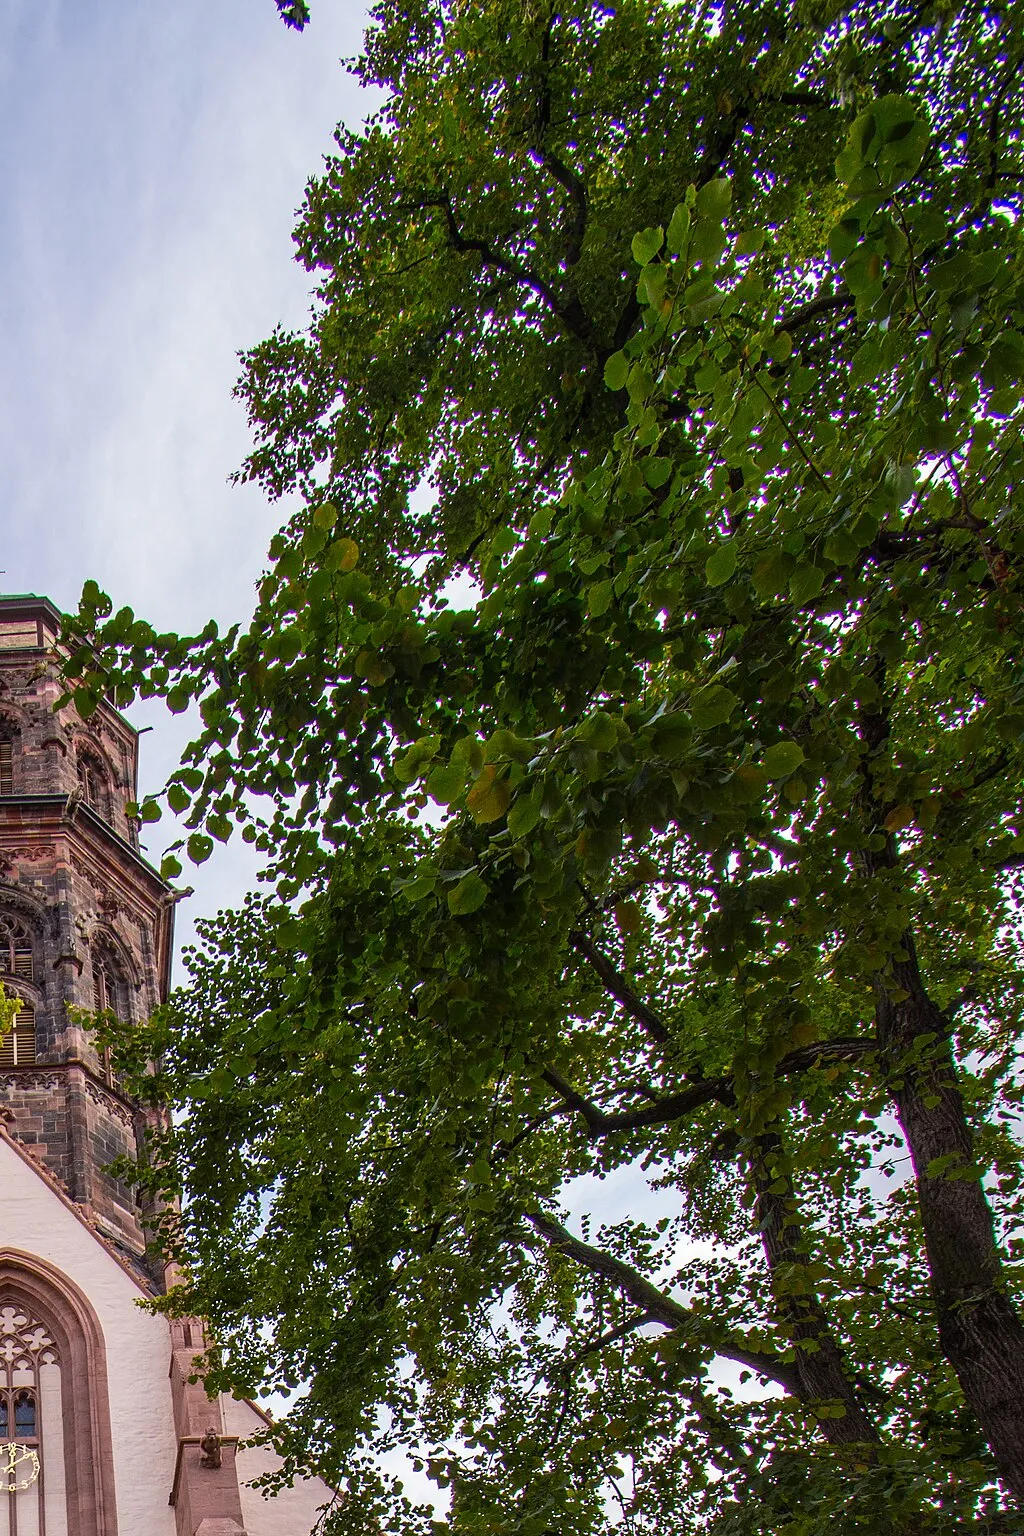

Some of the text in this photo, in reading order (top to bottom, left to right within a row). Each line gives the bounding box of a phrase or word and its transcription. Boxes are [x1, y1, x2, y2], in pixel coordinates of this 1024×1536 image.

[7, 1442, 17, 1451] 12
[8, 1483, 16, 1491] 6
[21, 1480, 28, 1489] 5
